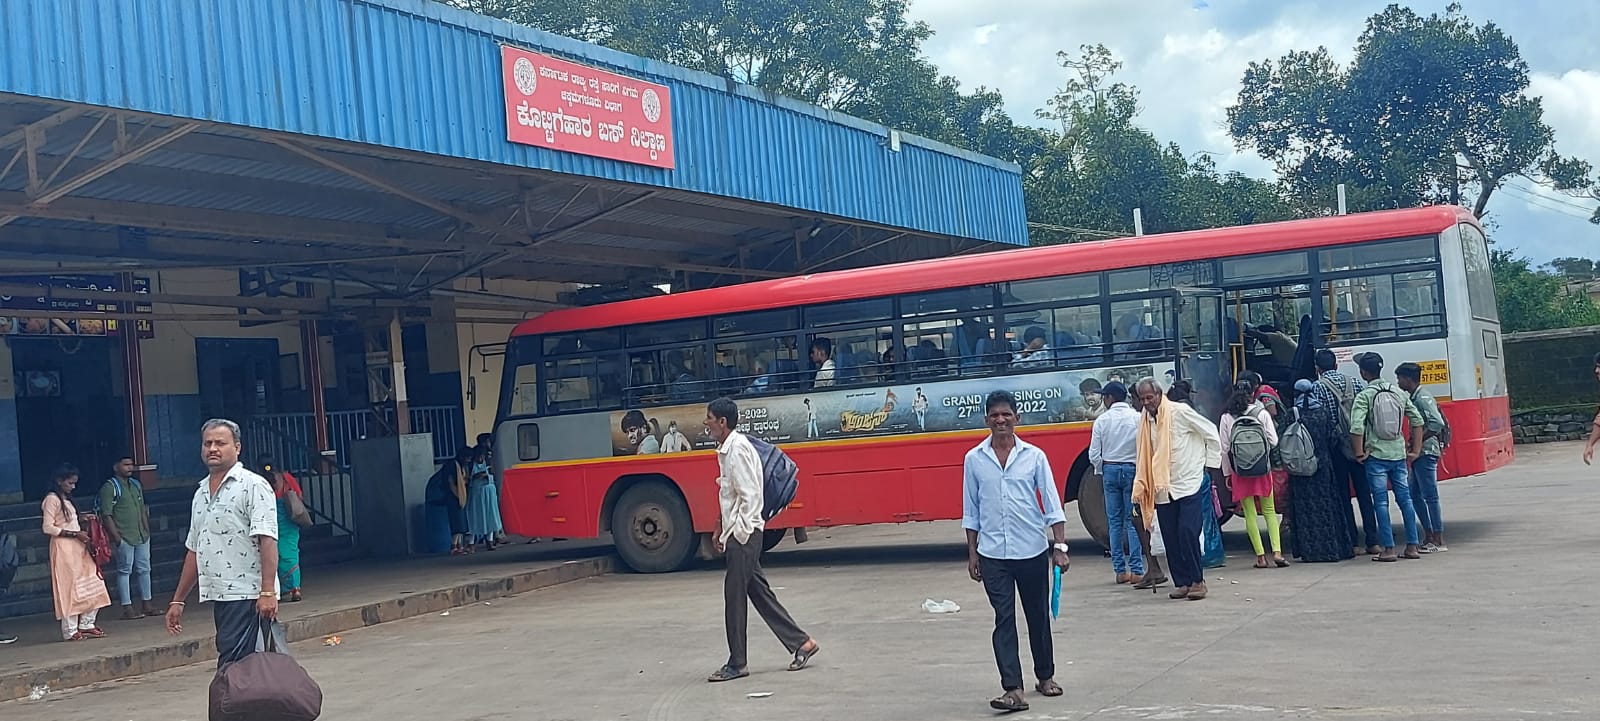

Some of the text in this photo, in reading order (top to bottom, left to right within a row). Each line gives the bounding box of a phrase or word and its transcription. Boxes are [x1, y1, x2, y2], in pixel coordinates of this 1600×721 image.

[571, 74, 587, 92] ರಾಜ್ಯ
[516, 99, 666, 161] ಕೊಟ್ಟಿಗೆಹಾರ ಬಸ್ ನಿಲ್ದಾಣ
[943, 395, 981, 407] GRAND
[1045, 388, 1061, 399] ON
[959, 406, 981, 418] 27th
[1016, 401, 1047, 414] 2022
